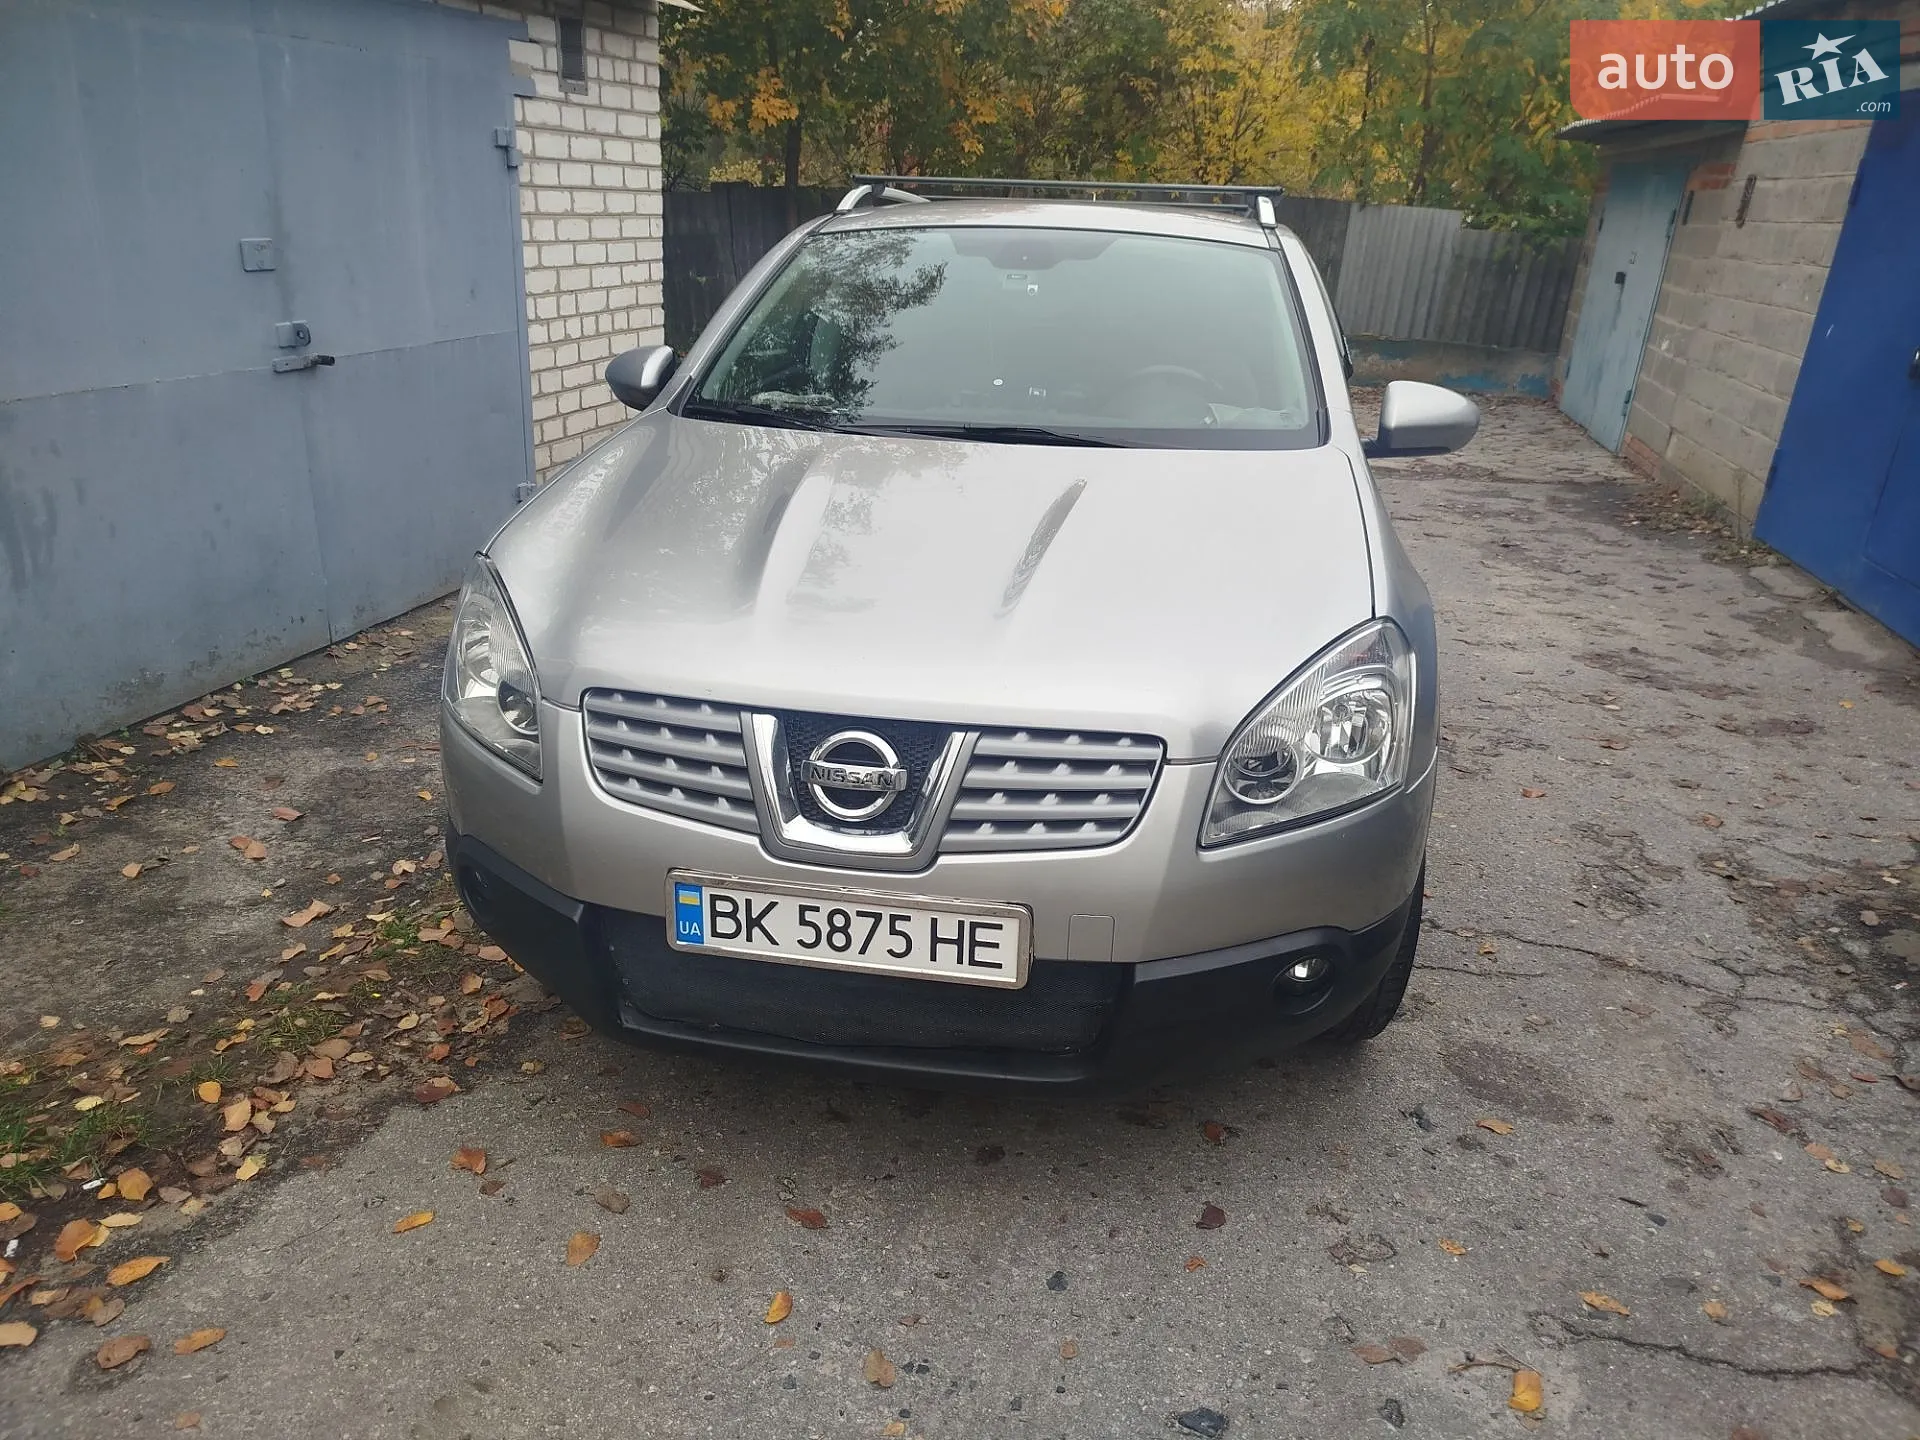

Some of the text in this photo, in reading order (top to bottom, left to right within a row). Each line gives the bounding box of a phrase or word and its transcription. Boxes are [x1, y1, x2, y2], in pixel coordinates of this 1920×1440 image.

[810, 765, 894, 787] NISSAN
[679, 920, 701, 937] UA
[709, 893, 1003, 970] BK 5875 HE
